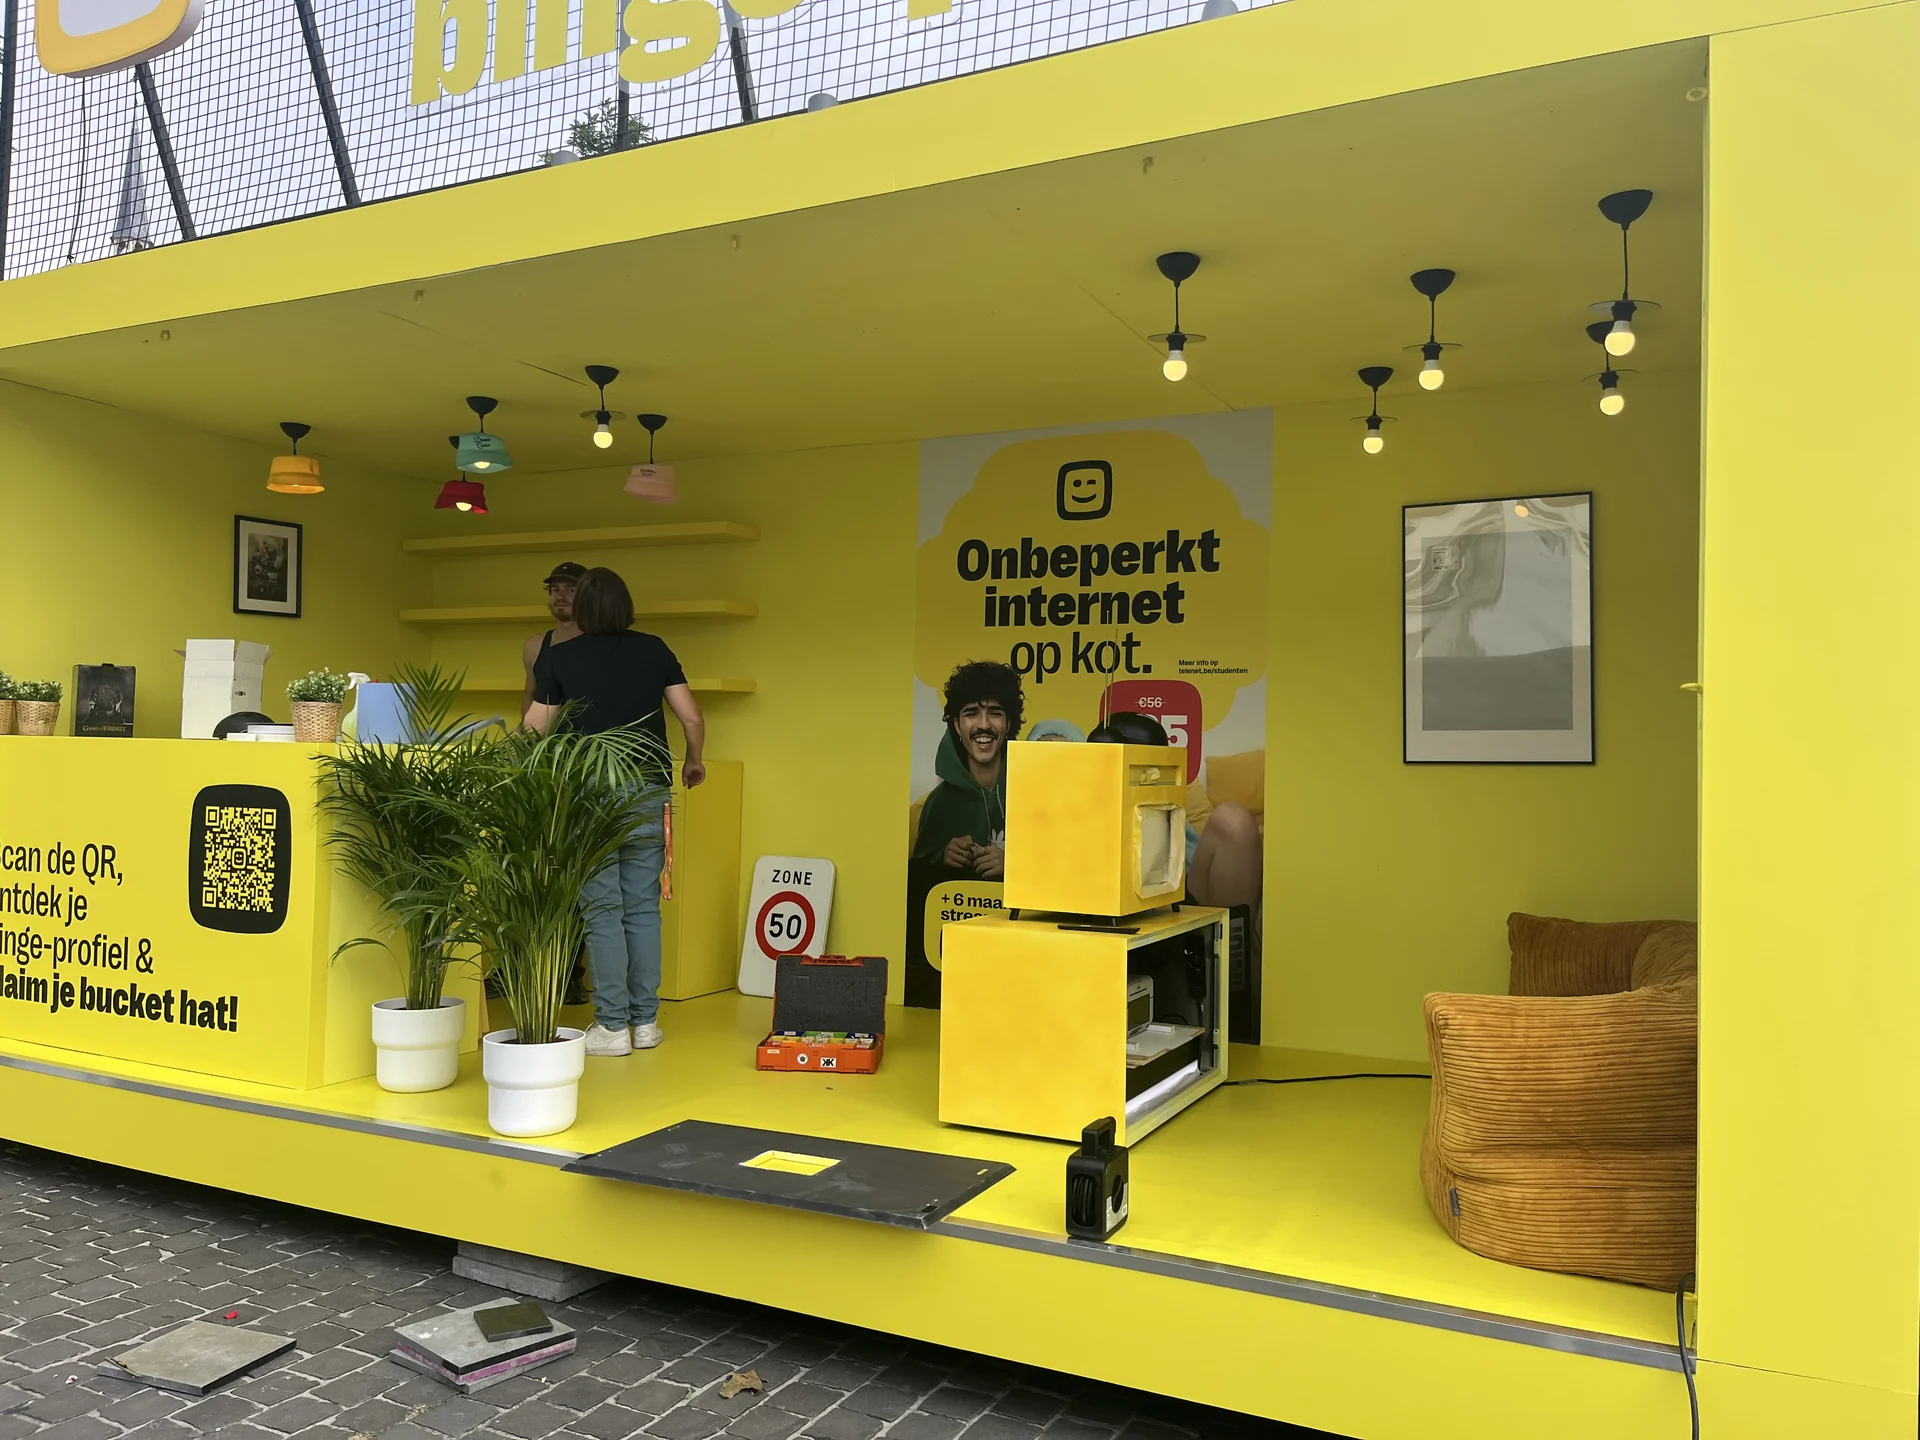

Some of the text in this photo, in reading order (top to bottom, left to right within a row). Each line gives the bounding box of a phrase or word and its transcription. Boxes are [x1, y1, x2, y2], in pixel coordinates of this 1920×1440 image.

[957, 529, 1220, 586] Onbeperkt
[984, 581, 1185, 627] internet
[1011, 632, 1152, 684] op kot.
[1210, 660, 1219, 668] op
[1138, 697, 1163, 708] €56
[0, 841, 123, 887] can de QR,
[771, 869, 812, 885] ZONE
[0, 882, 88, 927] ntdek je
[940, 908, 989, 922] stre
[953, 892, 965, 907] 6
[967, 896, 1007, 910] maa
[0, 922, 154, 975] inge-profiel &
[768, 912, 802, 940] 50
[0, 964, 239, 1032] laim je bucket hat!
